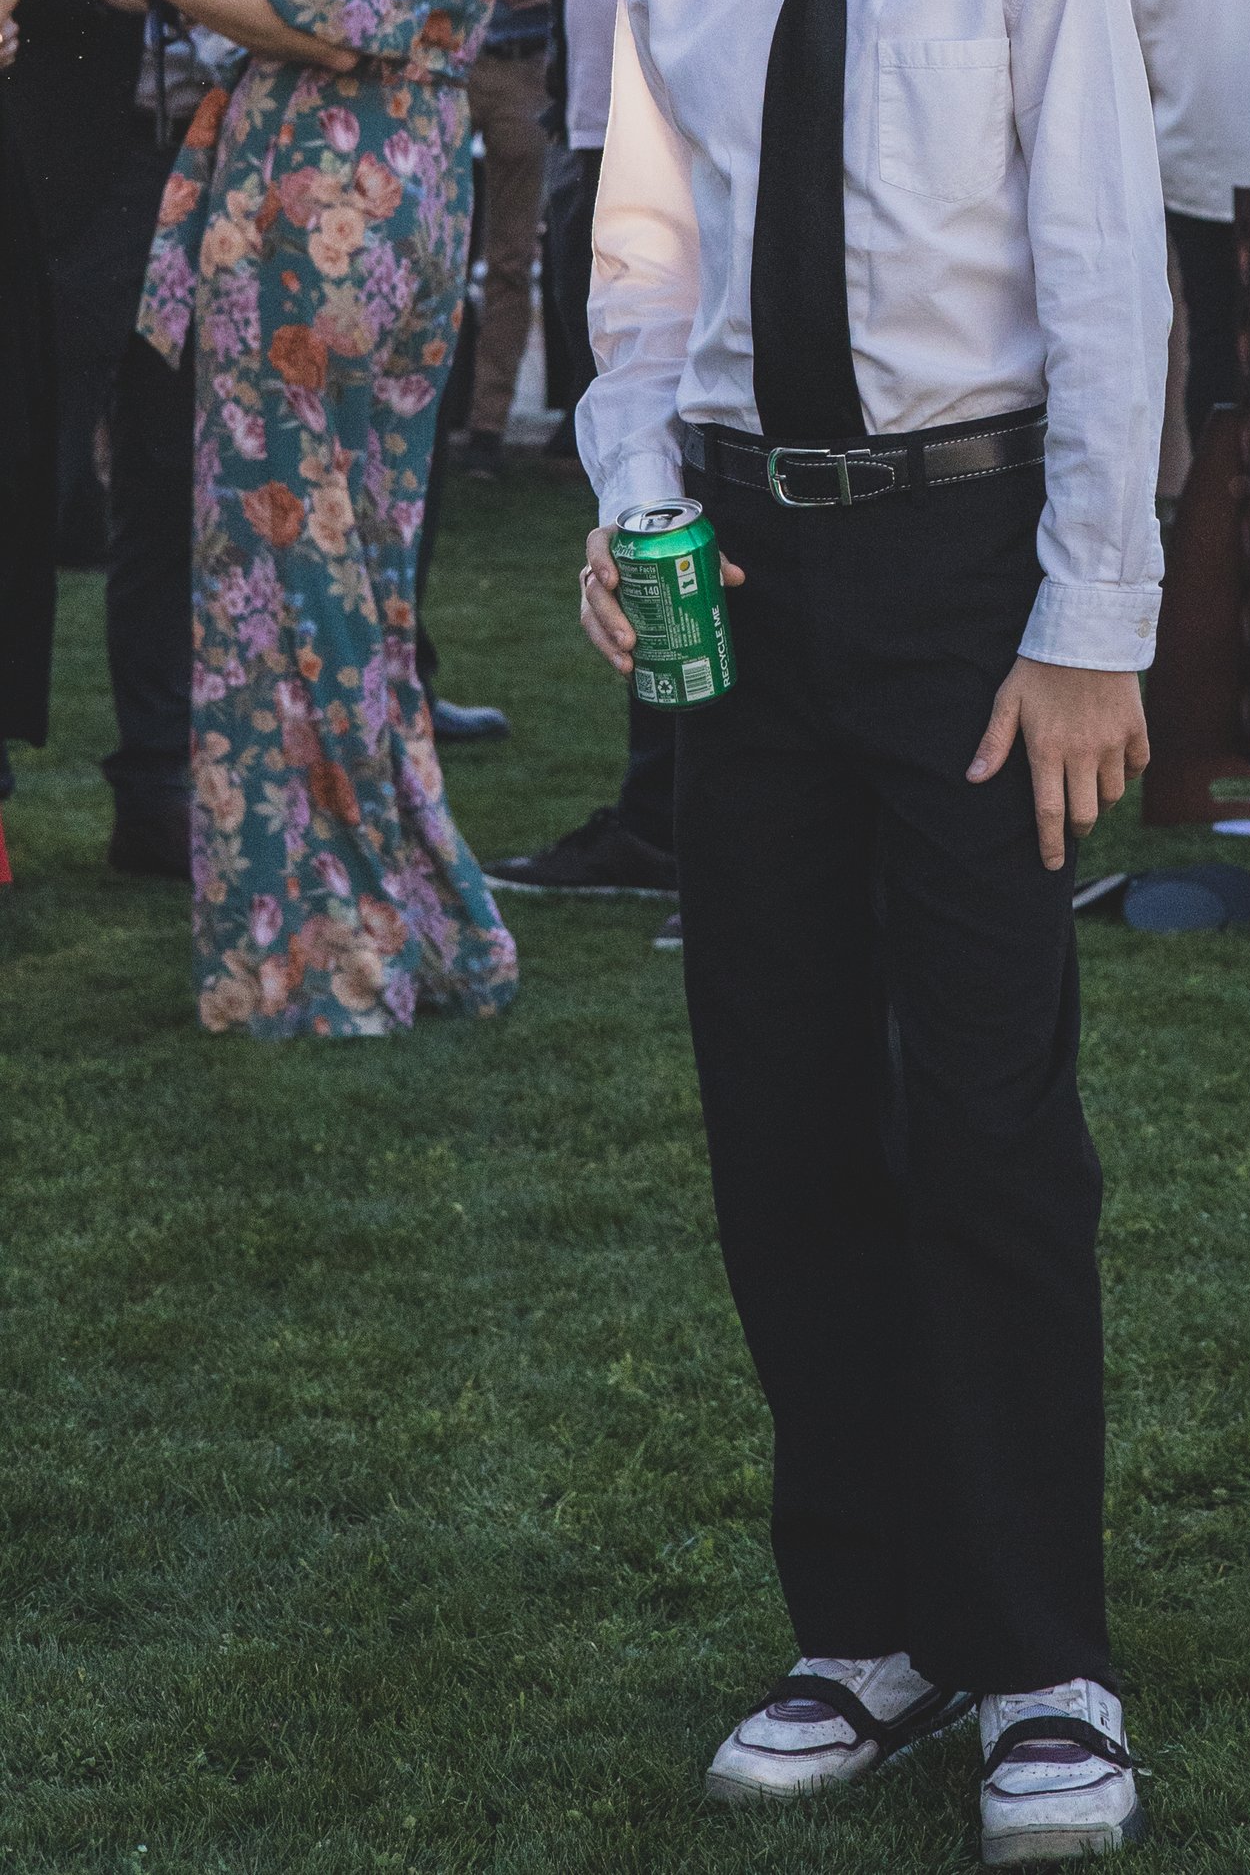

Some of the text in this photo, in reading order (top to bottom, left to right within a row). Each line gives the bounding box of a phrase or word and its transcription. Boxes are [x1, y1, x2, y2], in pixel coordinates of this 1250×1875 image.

[643, 586, 660, 596] 140
[712, 605, 722, 626] ME
[715, 627, 731, 688] RECYCLE
[1099, 1701, 1111, 1731] FILA
